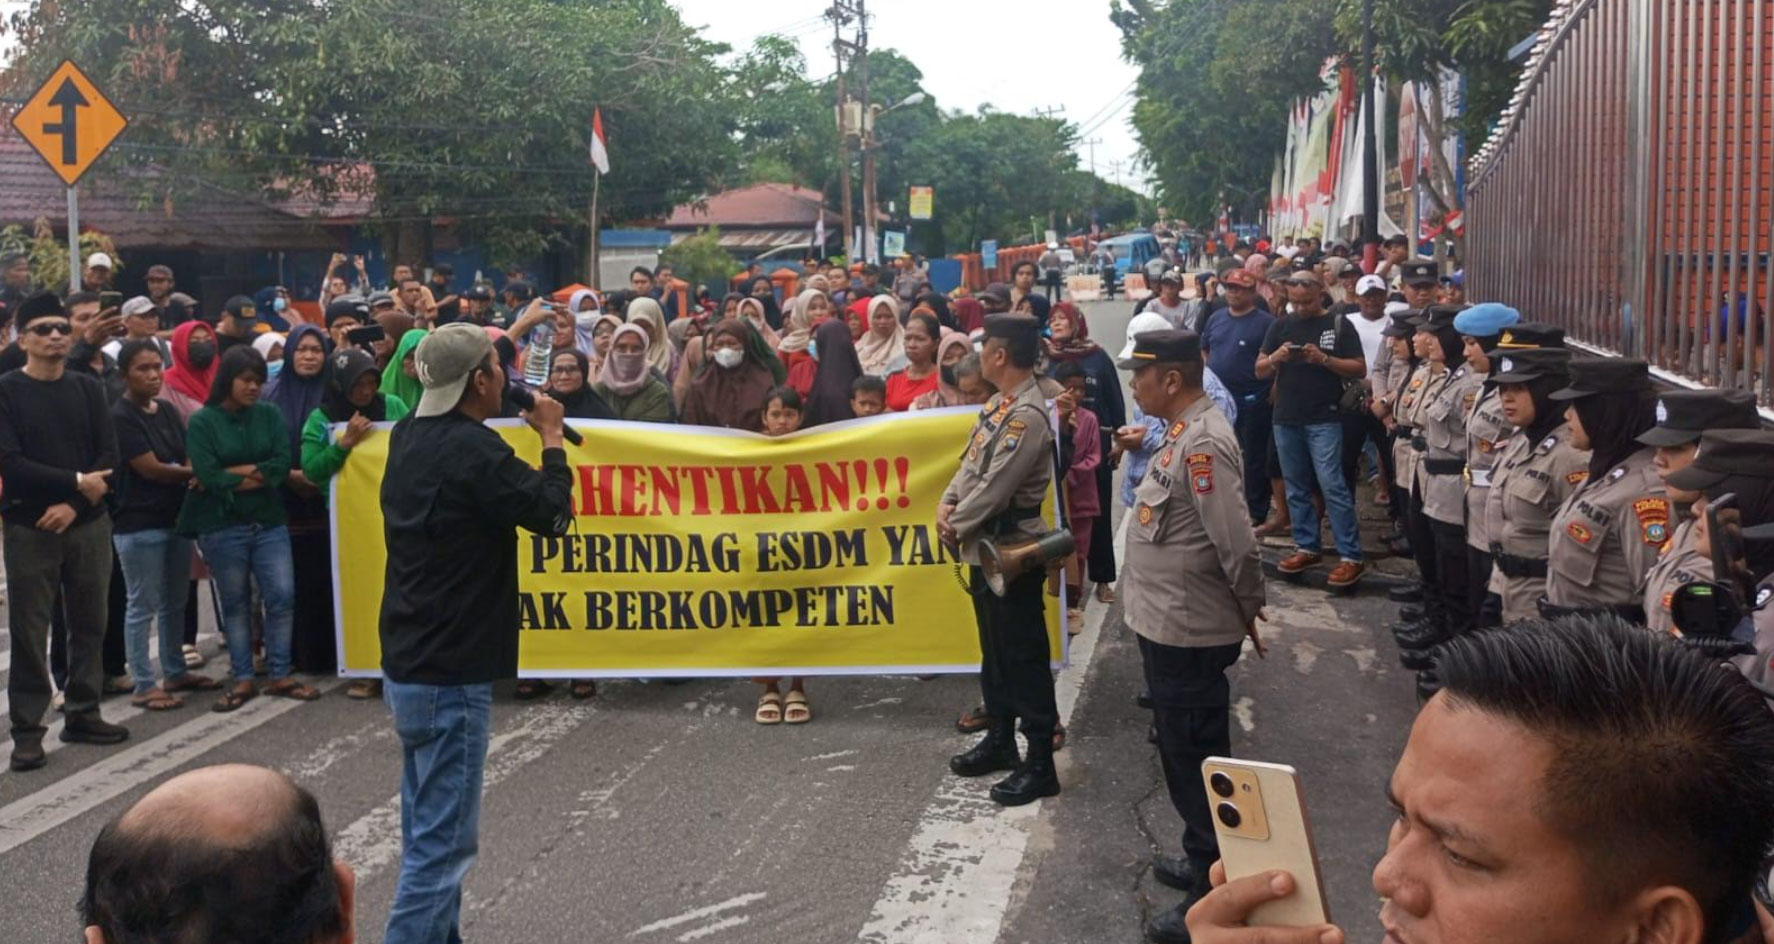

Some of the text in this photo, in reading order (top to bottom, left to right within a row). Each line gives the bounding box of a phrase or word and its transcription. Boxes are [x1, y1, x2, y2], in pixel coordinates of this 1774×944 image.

[571, 456, 910, 517] HENTIKAN!!!
[1577, 500, 1610, 527] POLRI
[530, 524, 961, 573] PERINDAG ESDM YAN
[518, 585, 895, 630] AK BERKOMPETEN
